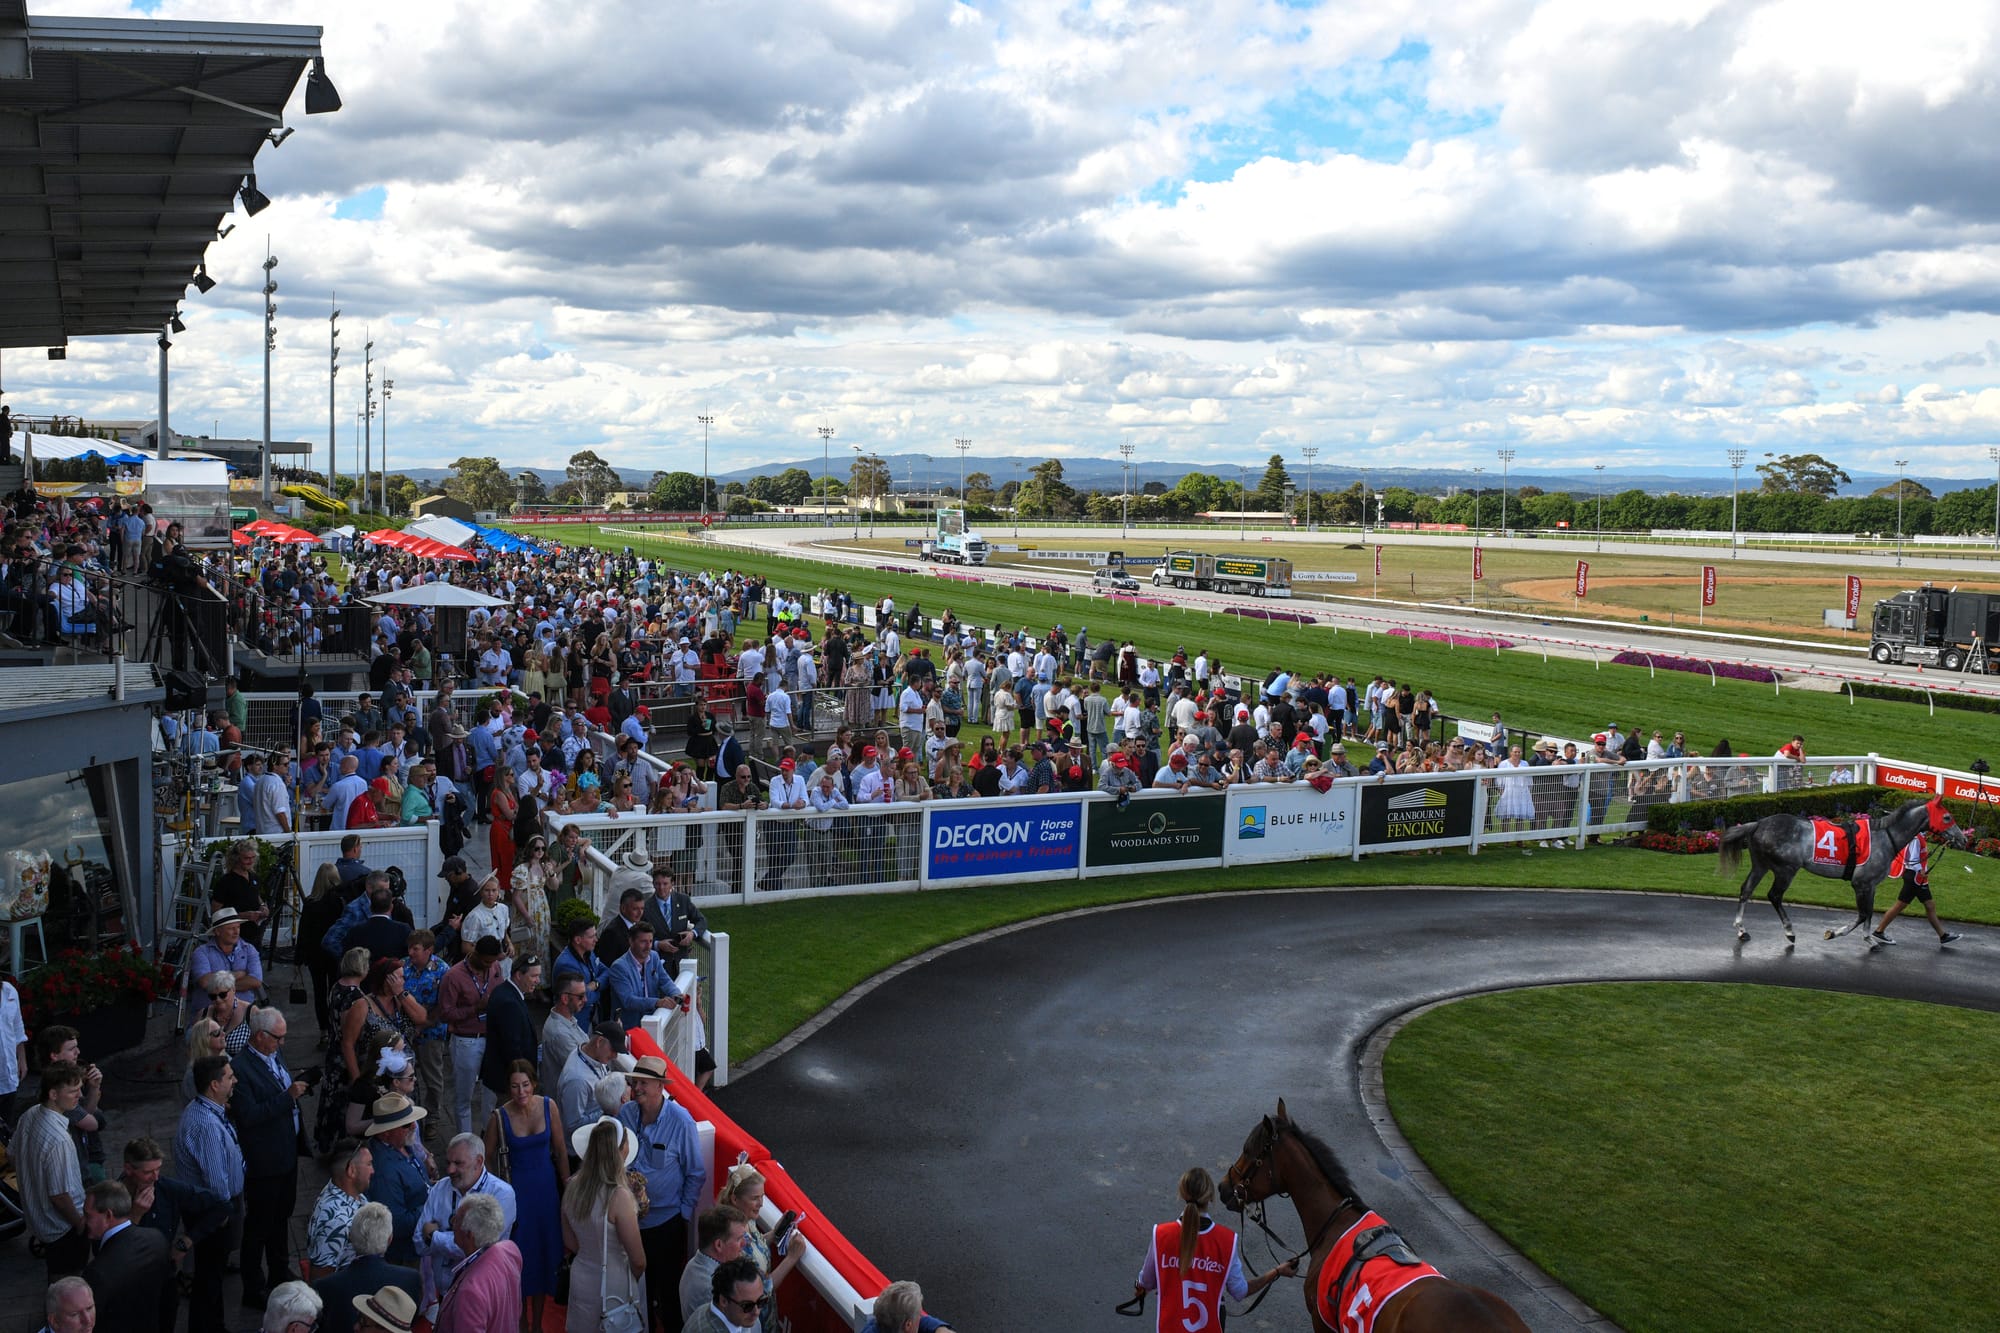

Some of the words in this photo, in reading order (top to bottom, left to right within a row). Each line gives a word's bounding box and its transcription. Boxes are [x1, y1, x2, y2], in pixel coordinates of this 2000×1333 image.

[1705, 569, 1714, 604] Ladbrokes
[1849, 577, 1860, 617] Ladbrokes
[1885, 772, 1928, 789] Ladbrokes
[1271, 813, 1304, 826] BLUE
[1309, 811, 1345, 824] HILLS
[1387, 808, 1446, 822] CRANBOURNE
[1040, 819, 1074, 831] Horse
[1387, 820, 1444, 838] FENCING
[935, 821, 1030, 849] DECRON
[1040, 831, 1067, 842] Care
[1110, 836, 1172, 848] WOODLANDS
[1175, 834, 1200, 844] STUD
[1816, 830, 1838, 857] 4
[934, 851, 960, 865] the
[964, 848, 1023, 863] trainers
[1029, 844, 1073, 858] friend
[1182, 1279, 1209, 1333] 5
